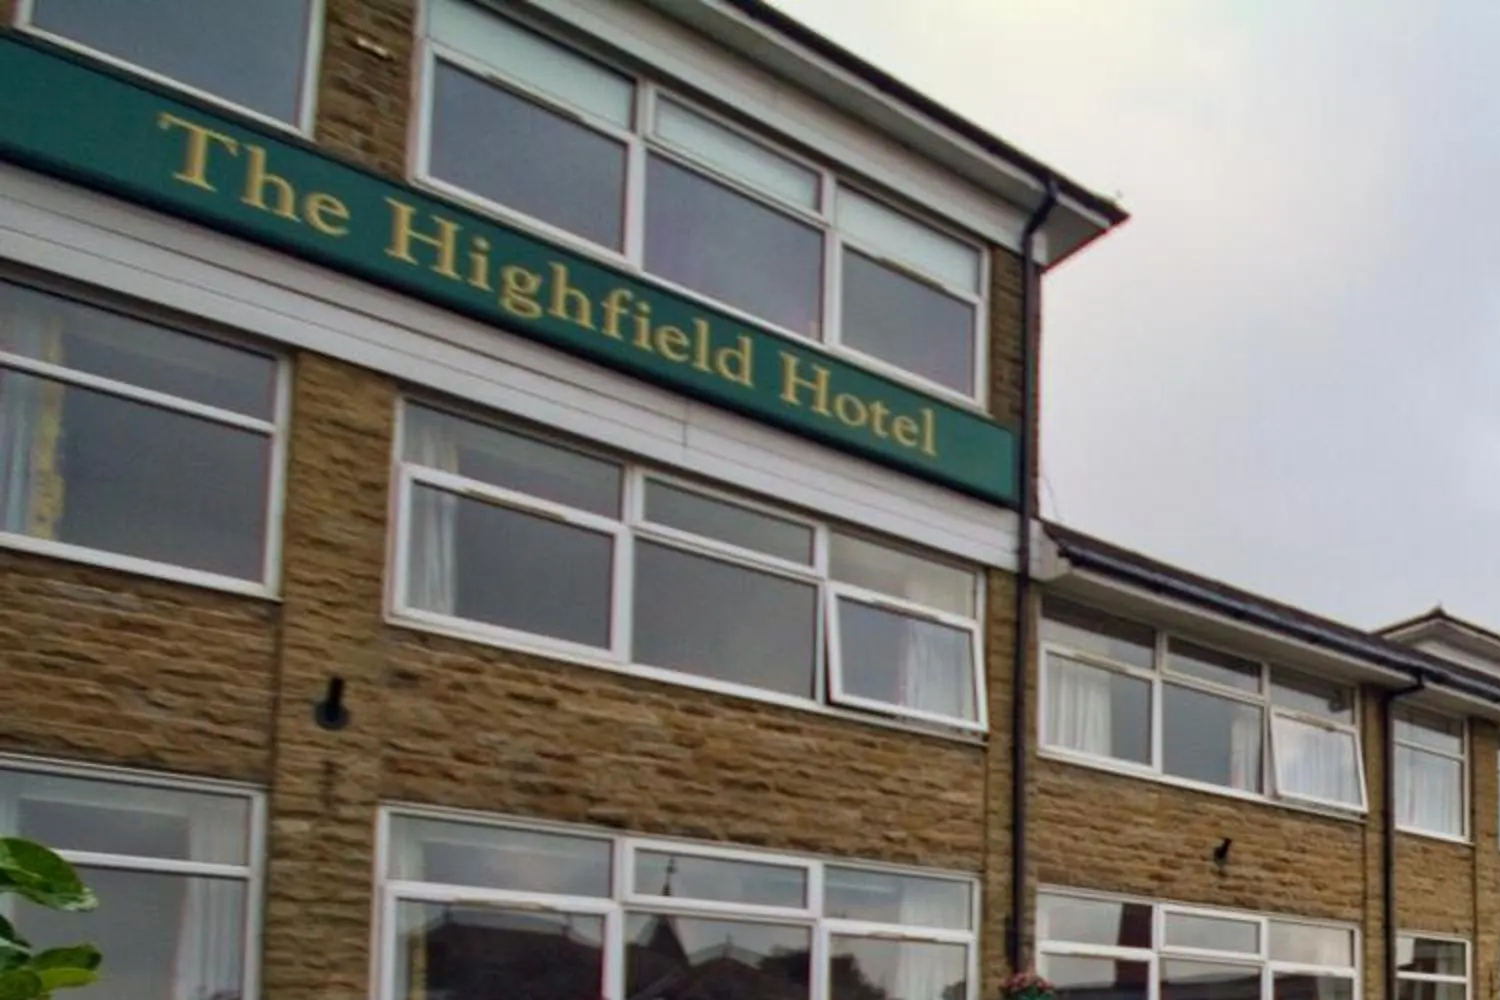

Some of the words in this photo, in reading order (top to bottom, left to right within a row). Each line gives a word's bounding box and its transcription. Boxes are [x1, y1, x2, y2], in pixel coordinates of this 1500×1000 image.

[159, 113, 351, 237] The
[384, 198, 754, 387] Highfield
[780, 351, 937, 456] Hotel
